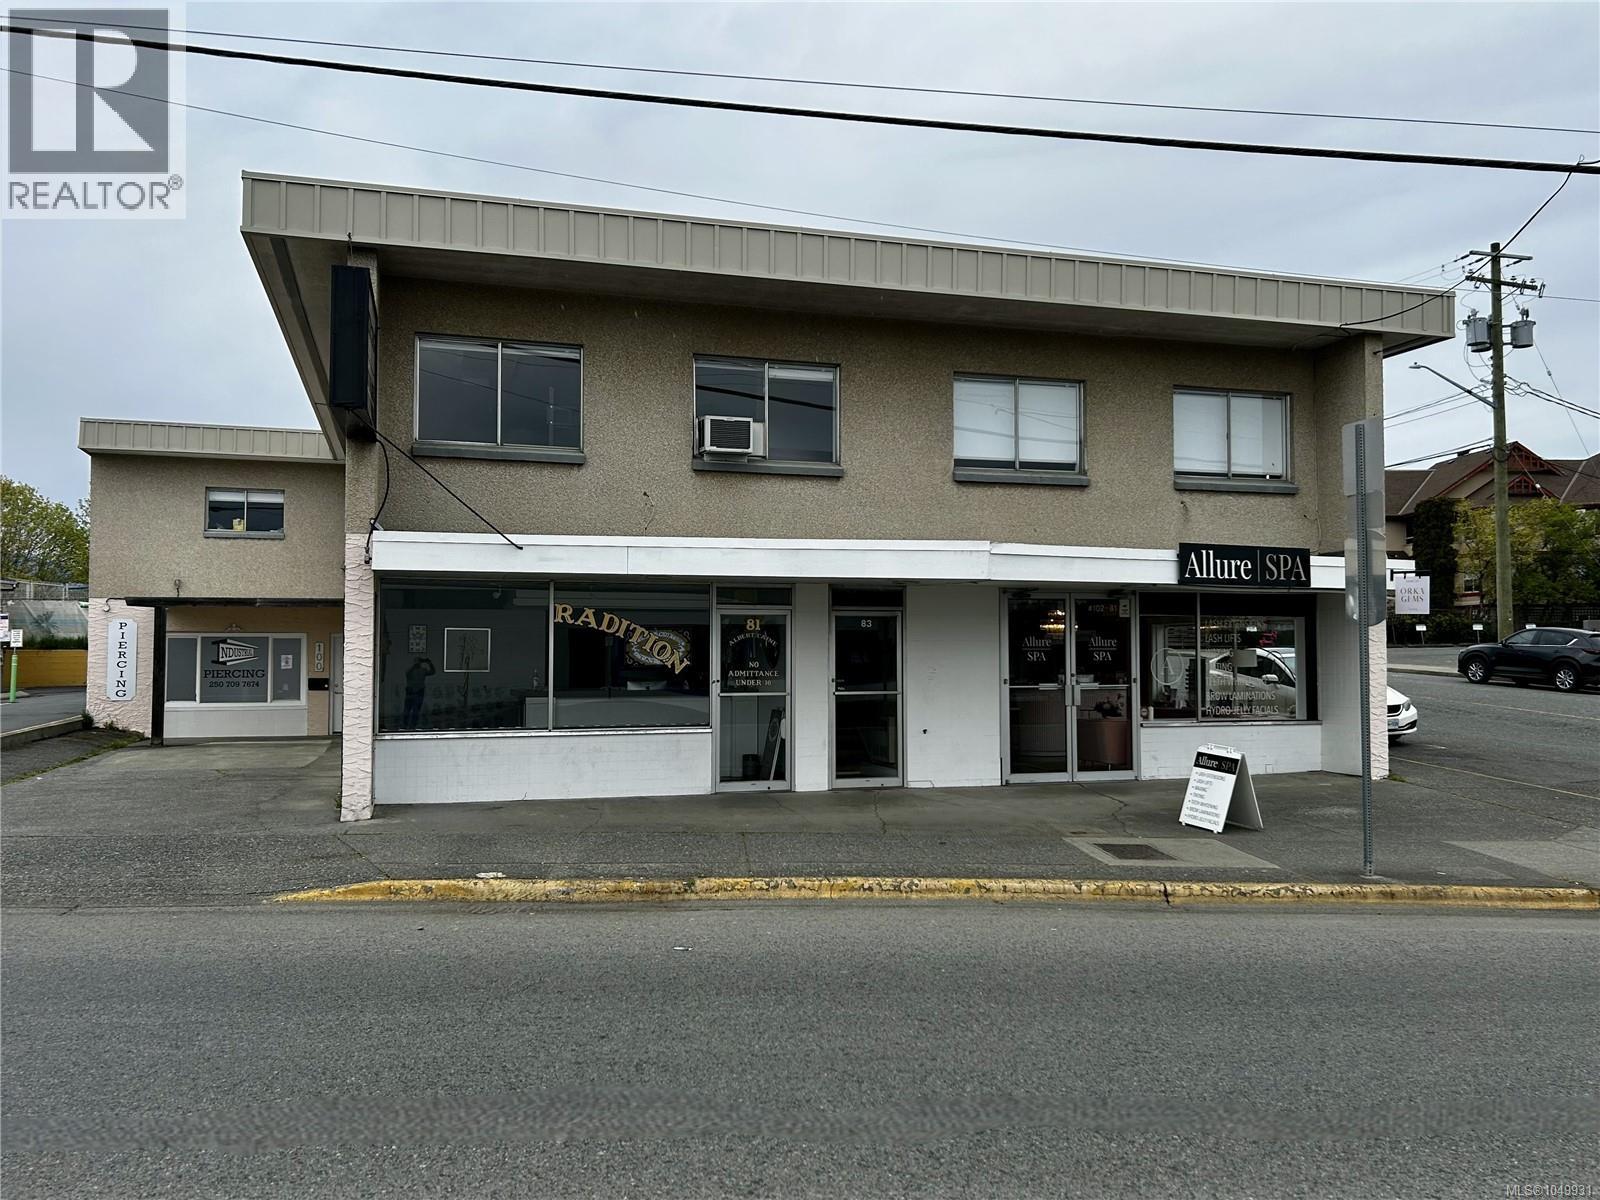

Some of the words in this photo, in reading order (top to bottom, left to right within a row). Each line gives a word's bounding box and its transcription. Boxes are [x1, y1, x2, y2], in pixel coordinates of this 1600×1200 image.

[1184, 550, 1252, 580] Allure
[1265, 553, 1308, 581] SPA
[1400, 587, 1425, 595] ORKA
[746, 618, 761, 631] 81
[860, 619, 872, 628] 83
[553, 603, 691, 675] RADITION
[1022, 636, 1052, 647] Allure
[1088, 636, 1117, 647] Allure
[1205, 633, 1223, 643] LASH
[1224, 633, 1242, 643] LIFTS
[115, 622, 128, 698] PIERCING
[315, 643, 323, 671] 100
[1027, 651, 1046, 661] SPA
[1093, 651, 1112, 661] SPA
[204, 669, 265, 679] PIERCING
[1206, 691, 1228, 701] BROW
[1228, 691, 1276, 701] LAMINATIONS
[1206, 705, 1231, 716] HYDRO
[1252, 705, 1279, 715] FACIALS
[1195, 756, 1219, 768] Allure
